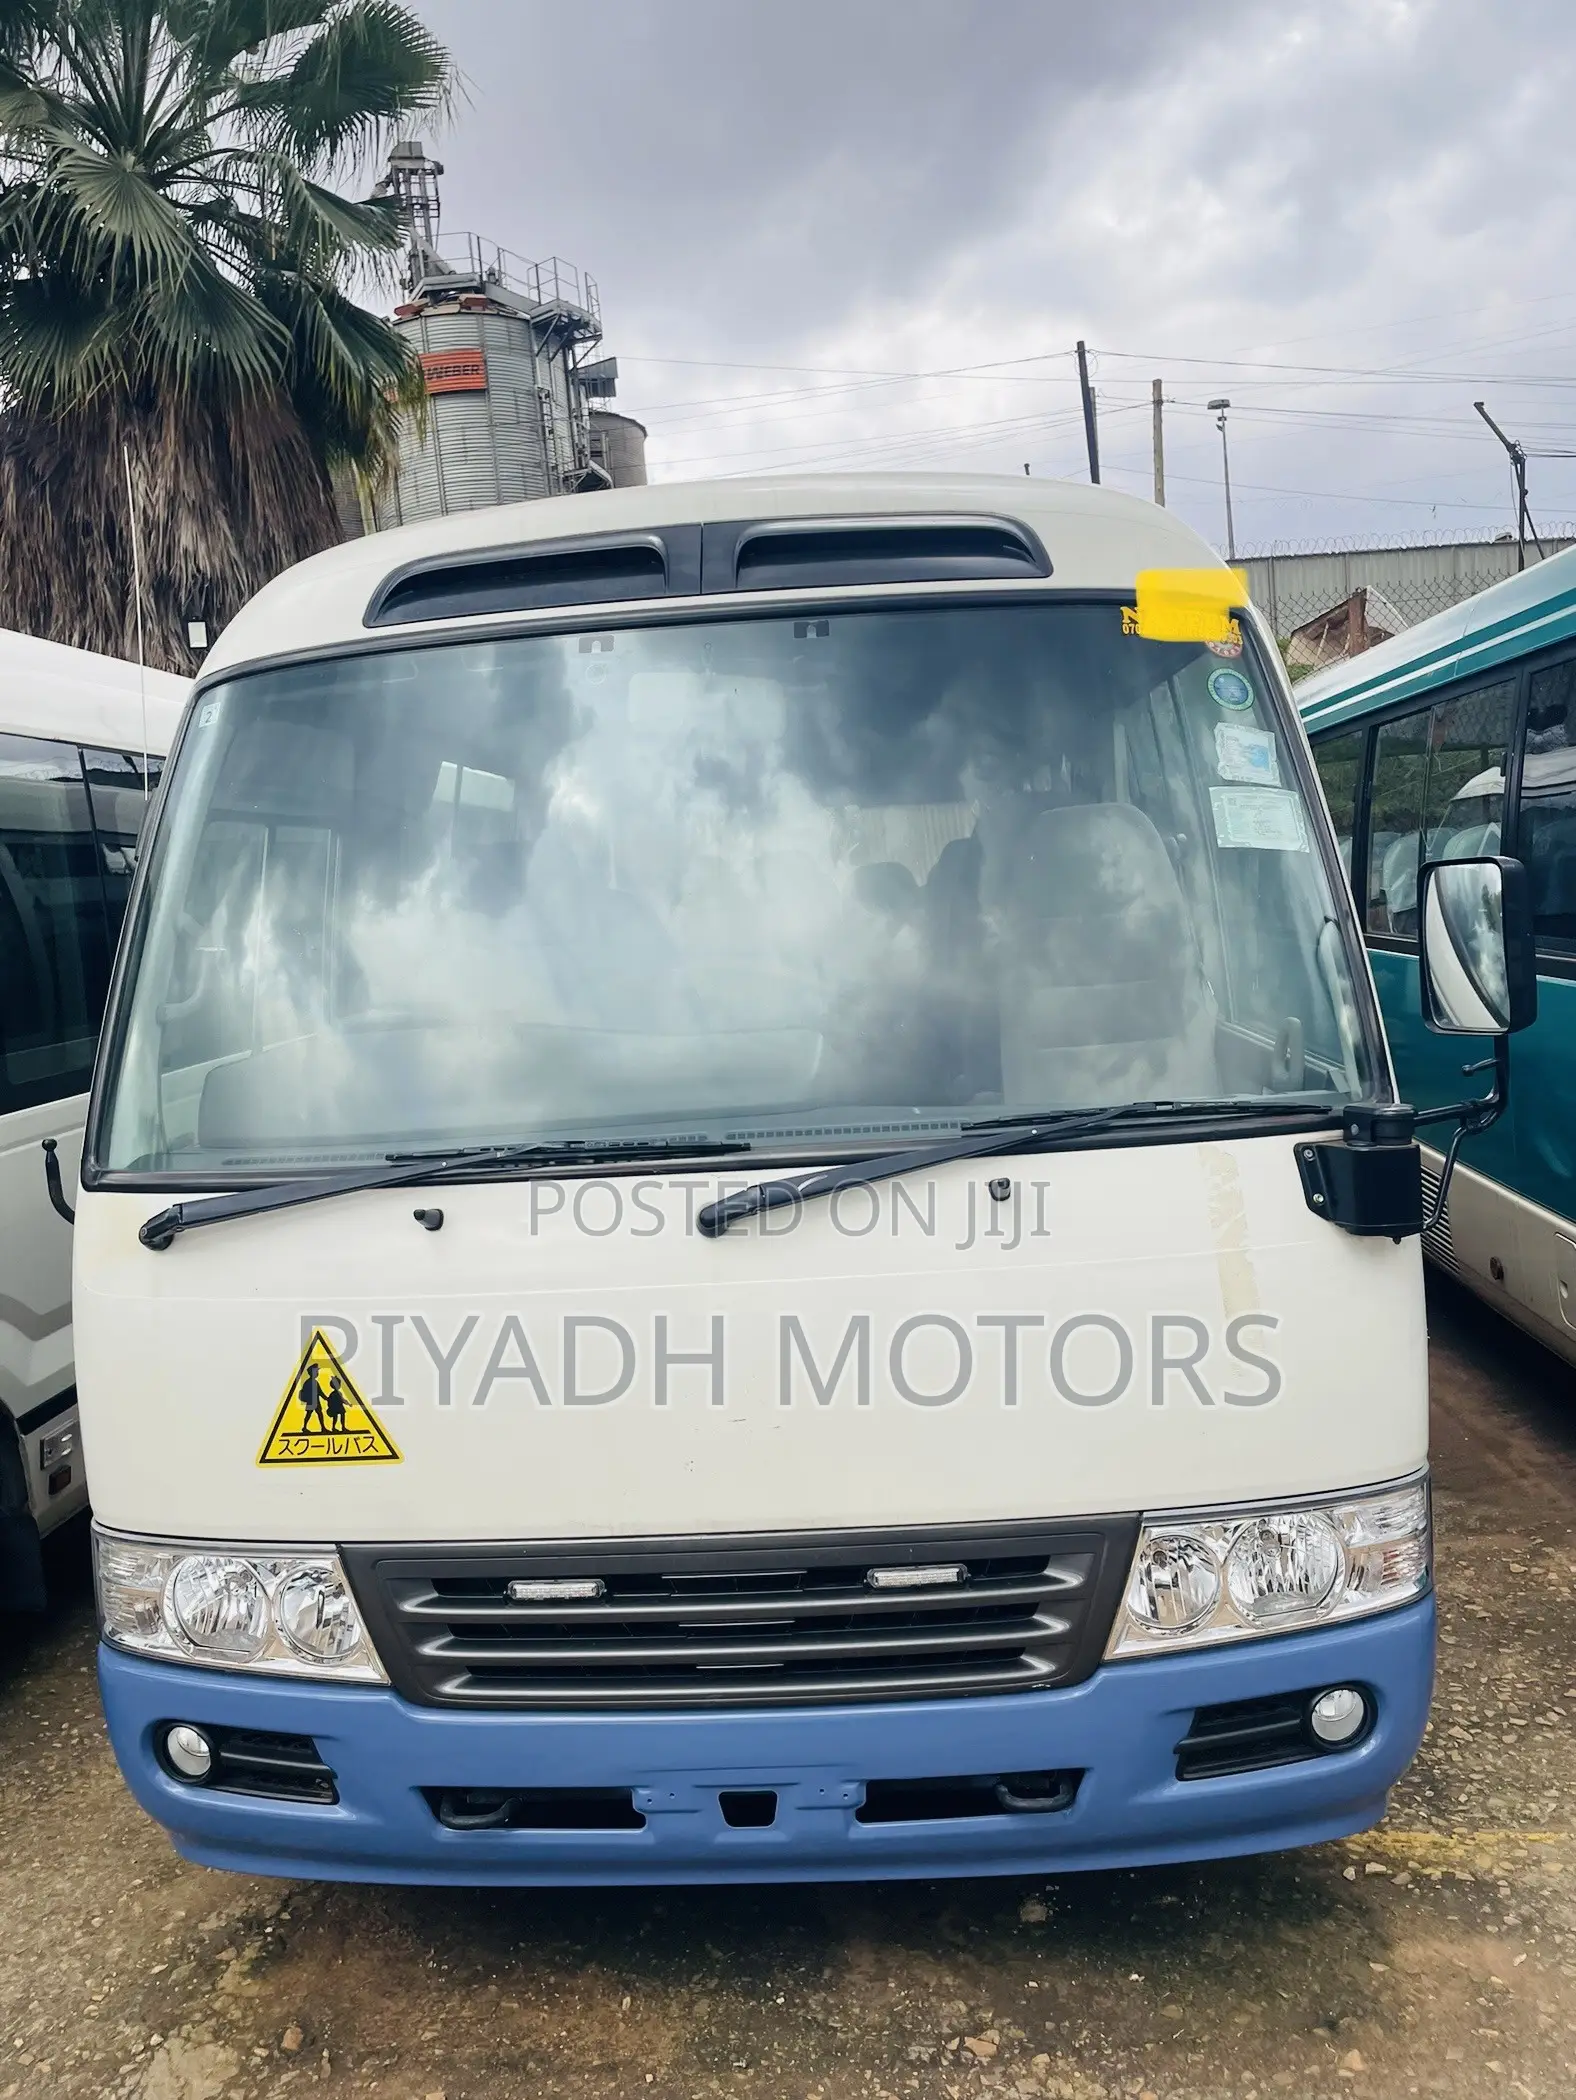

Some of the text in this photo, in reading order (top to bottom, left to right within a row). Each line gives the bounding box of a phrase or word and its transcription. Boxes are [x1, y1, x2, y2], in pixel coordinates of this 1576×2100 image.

[278, 1436, 379, 1456] スクールバス
